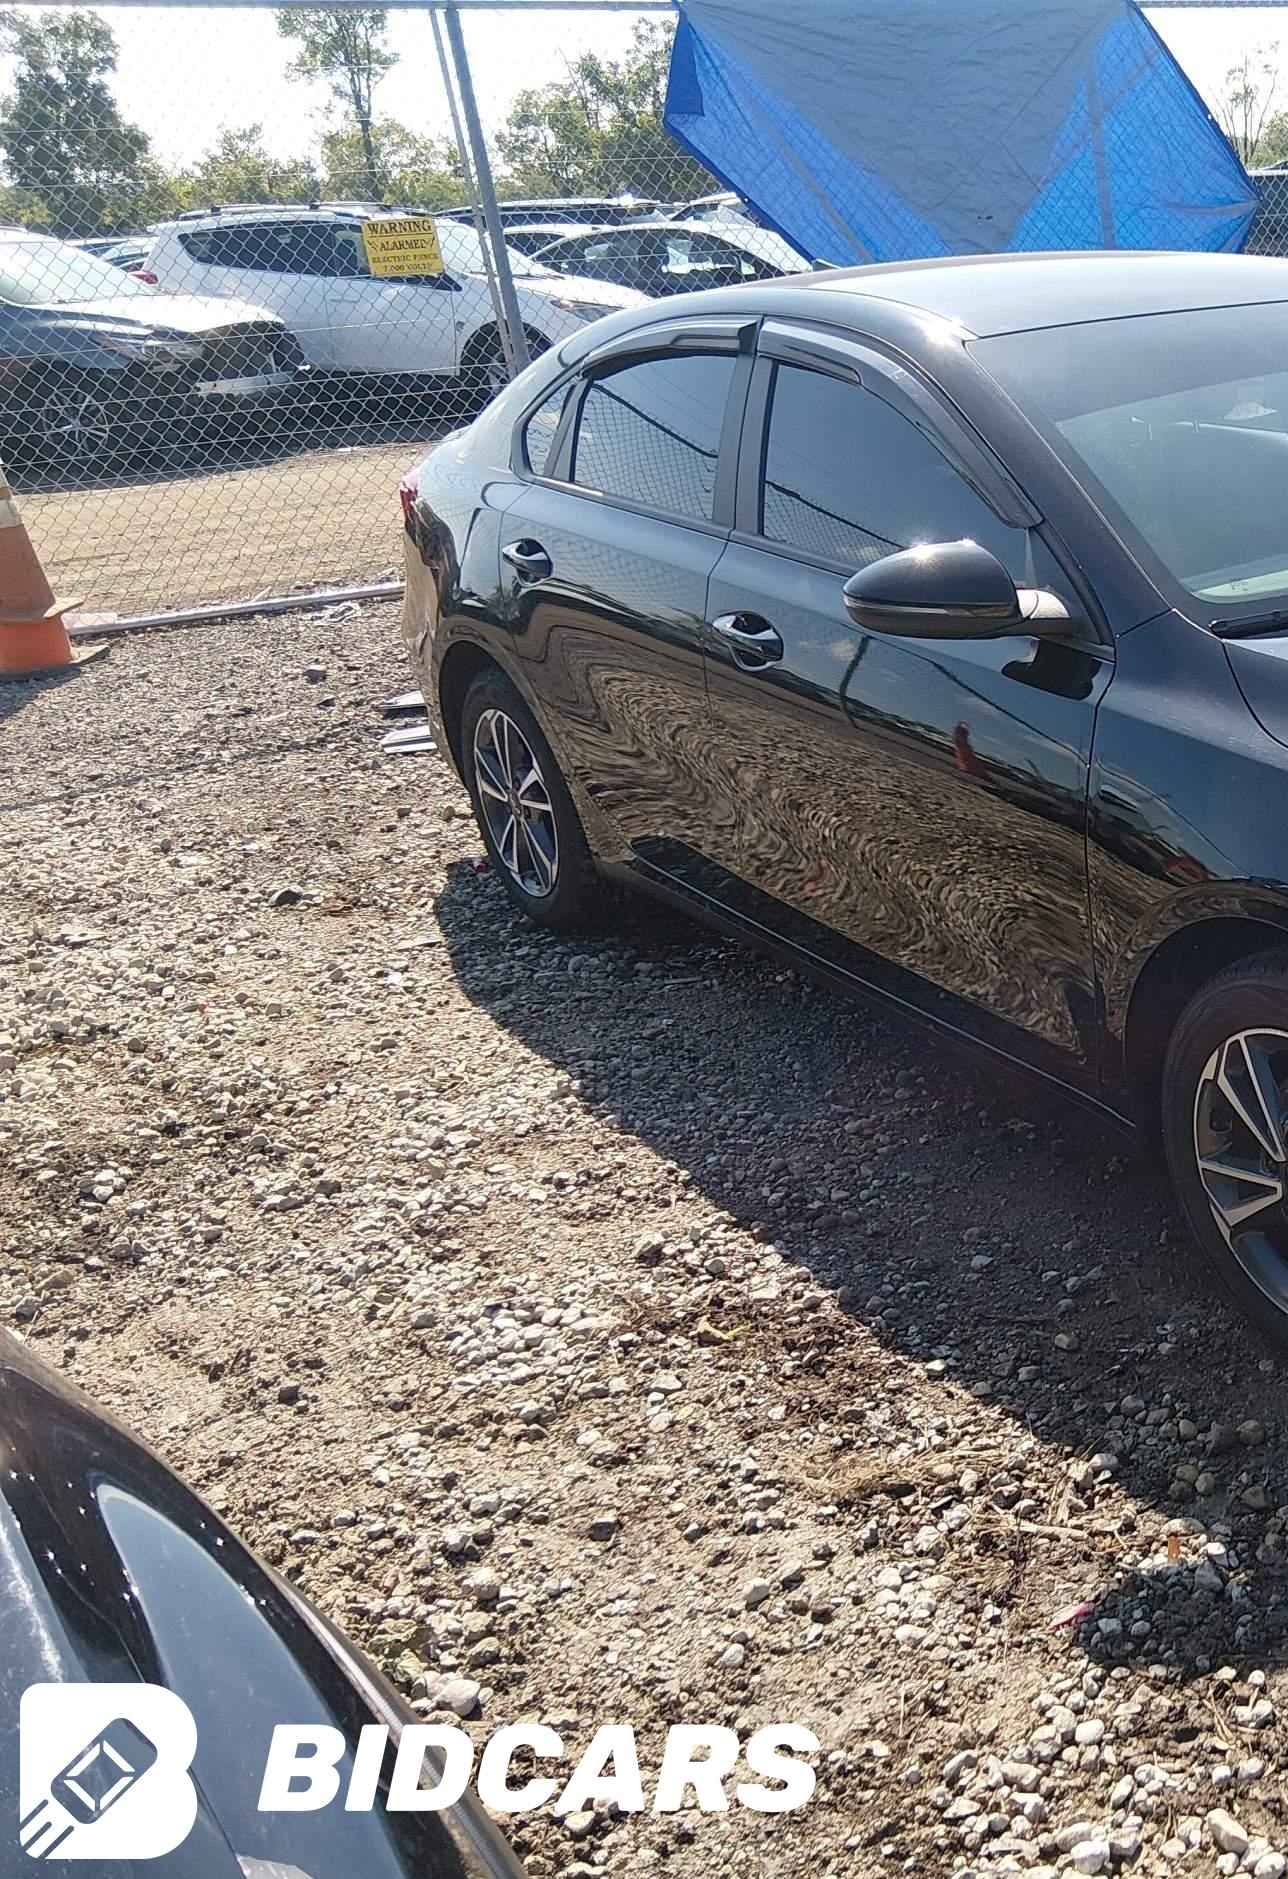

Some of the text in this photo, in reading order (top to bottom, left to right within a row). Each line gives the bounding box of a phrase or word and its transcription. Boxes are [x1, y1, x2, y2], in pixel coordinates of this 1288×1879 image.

[367, 219, 432, 236] WARNING
[380, 239, 428, 252] ALARMED
[371, 252, 440, 264] ELECTRIC FENCE
